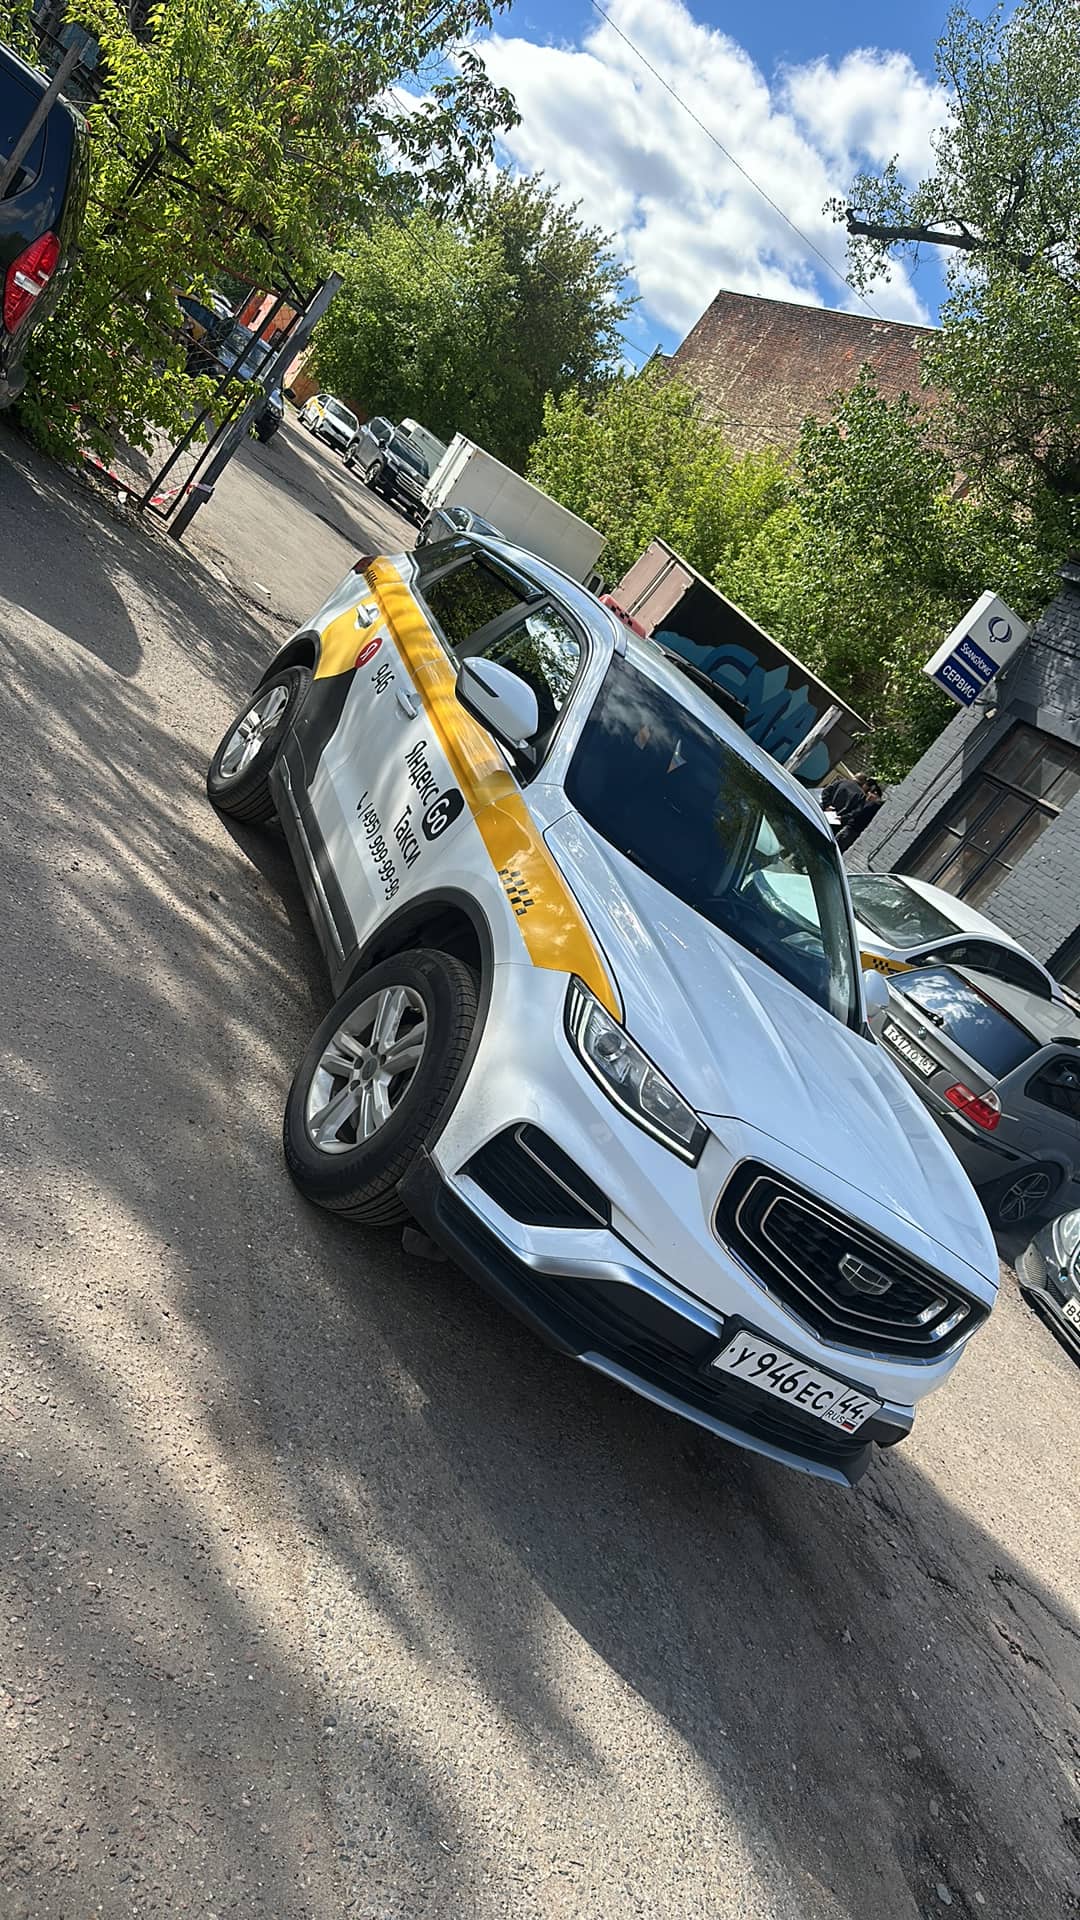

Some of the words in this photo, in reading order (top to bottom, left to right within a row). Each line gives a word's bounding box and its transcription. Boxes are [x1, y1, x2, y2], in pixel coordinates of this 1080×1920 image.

[371, 663, 395, 695] 946
[942, 665, 976, 699] СЕРВИС
[404, 740, 440, 807] Яндекс
[427, 798, 450, 834] Go
[358, 802, 381, 840] (495)
[393, 805, 421, 870] Такси
[826, 1409, 845, 1424] RUS
[839, 1395, 870, 1420] 44
